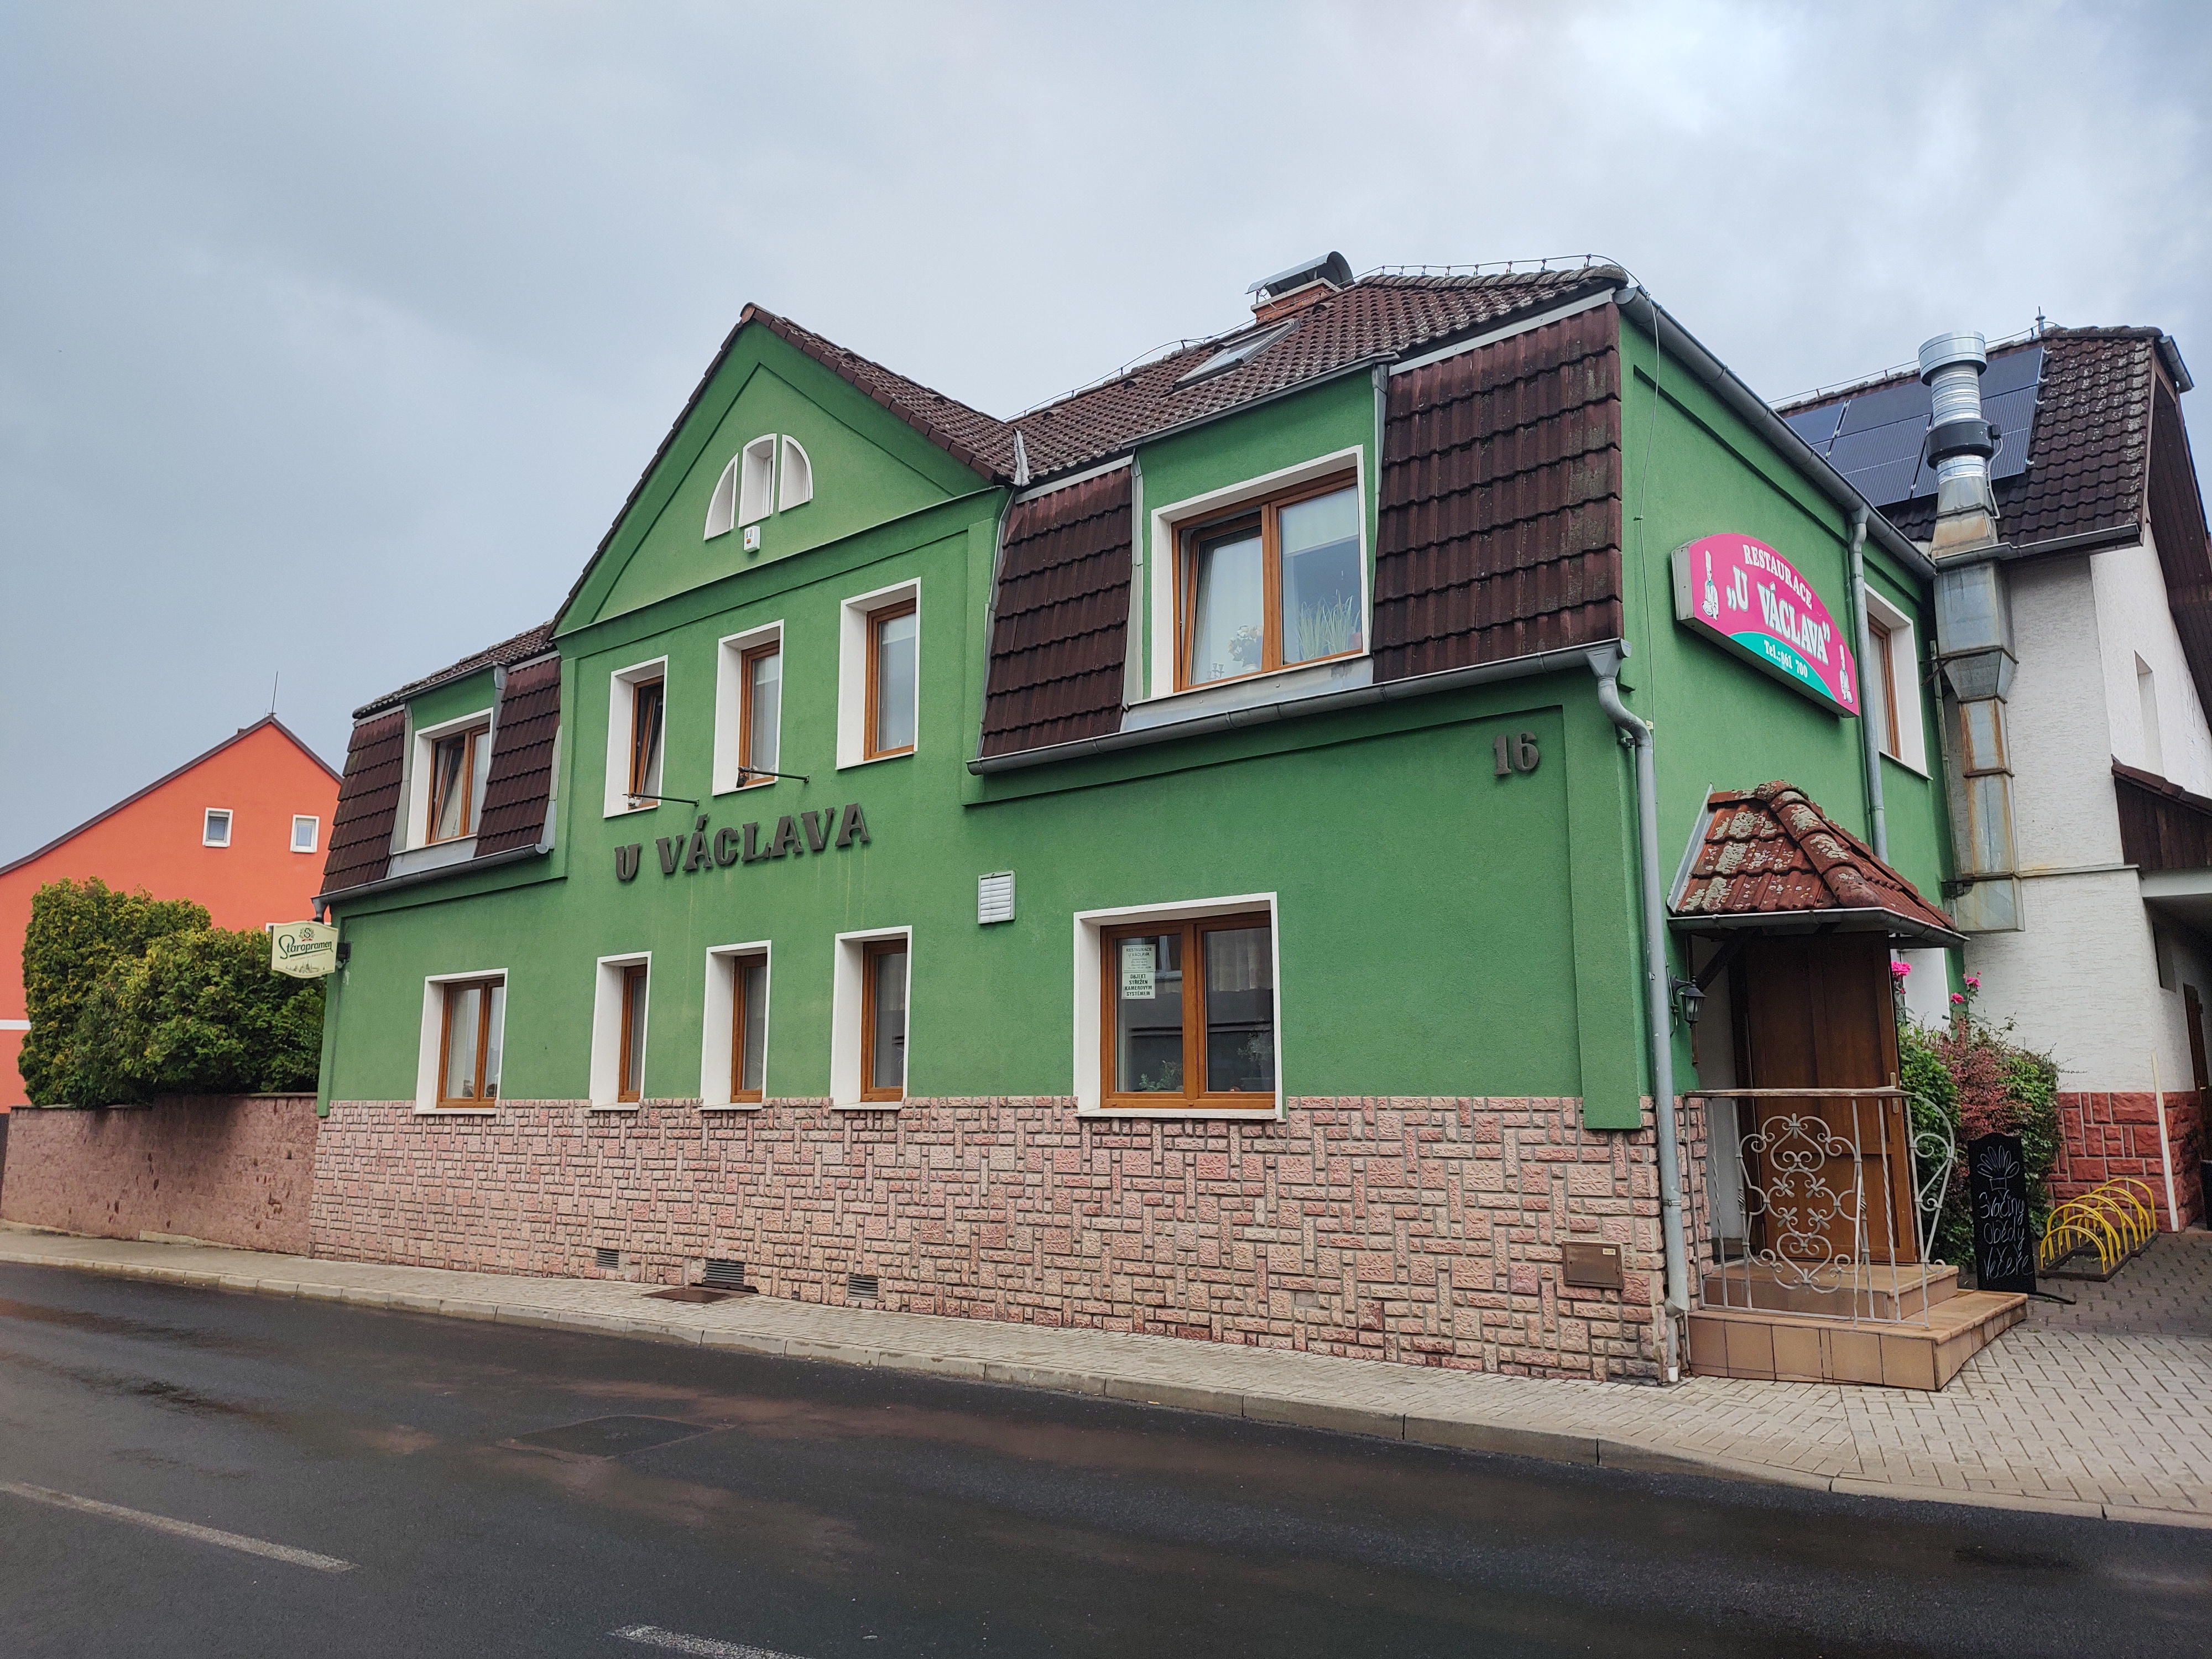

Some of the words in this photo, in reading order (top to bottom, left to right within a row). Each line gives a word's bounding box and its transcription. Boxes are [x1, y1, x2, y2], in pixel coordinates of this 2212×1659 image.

[1743, 544, 1813, 610] RESTAURACE
[1795, 659, 1808, 678] 700
[1494, 731, 1539, 775] 16
[614, 843, 640, 881] U
[655, 803, 870, 874] VÁCLAVA
[279, 935, 333, 959] Staropramen
